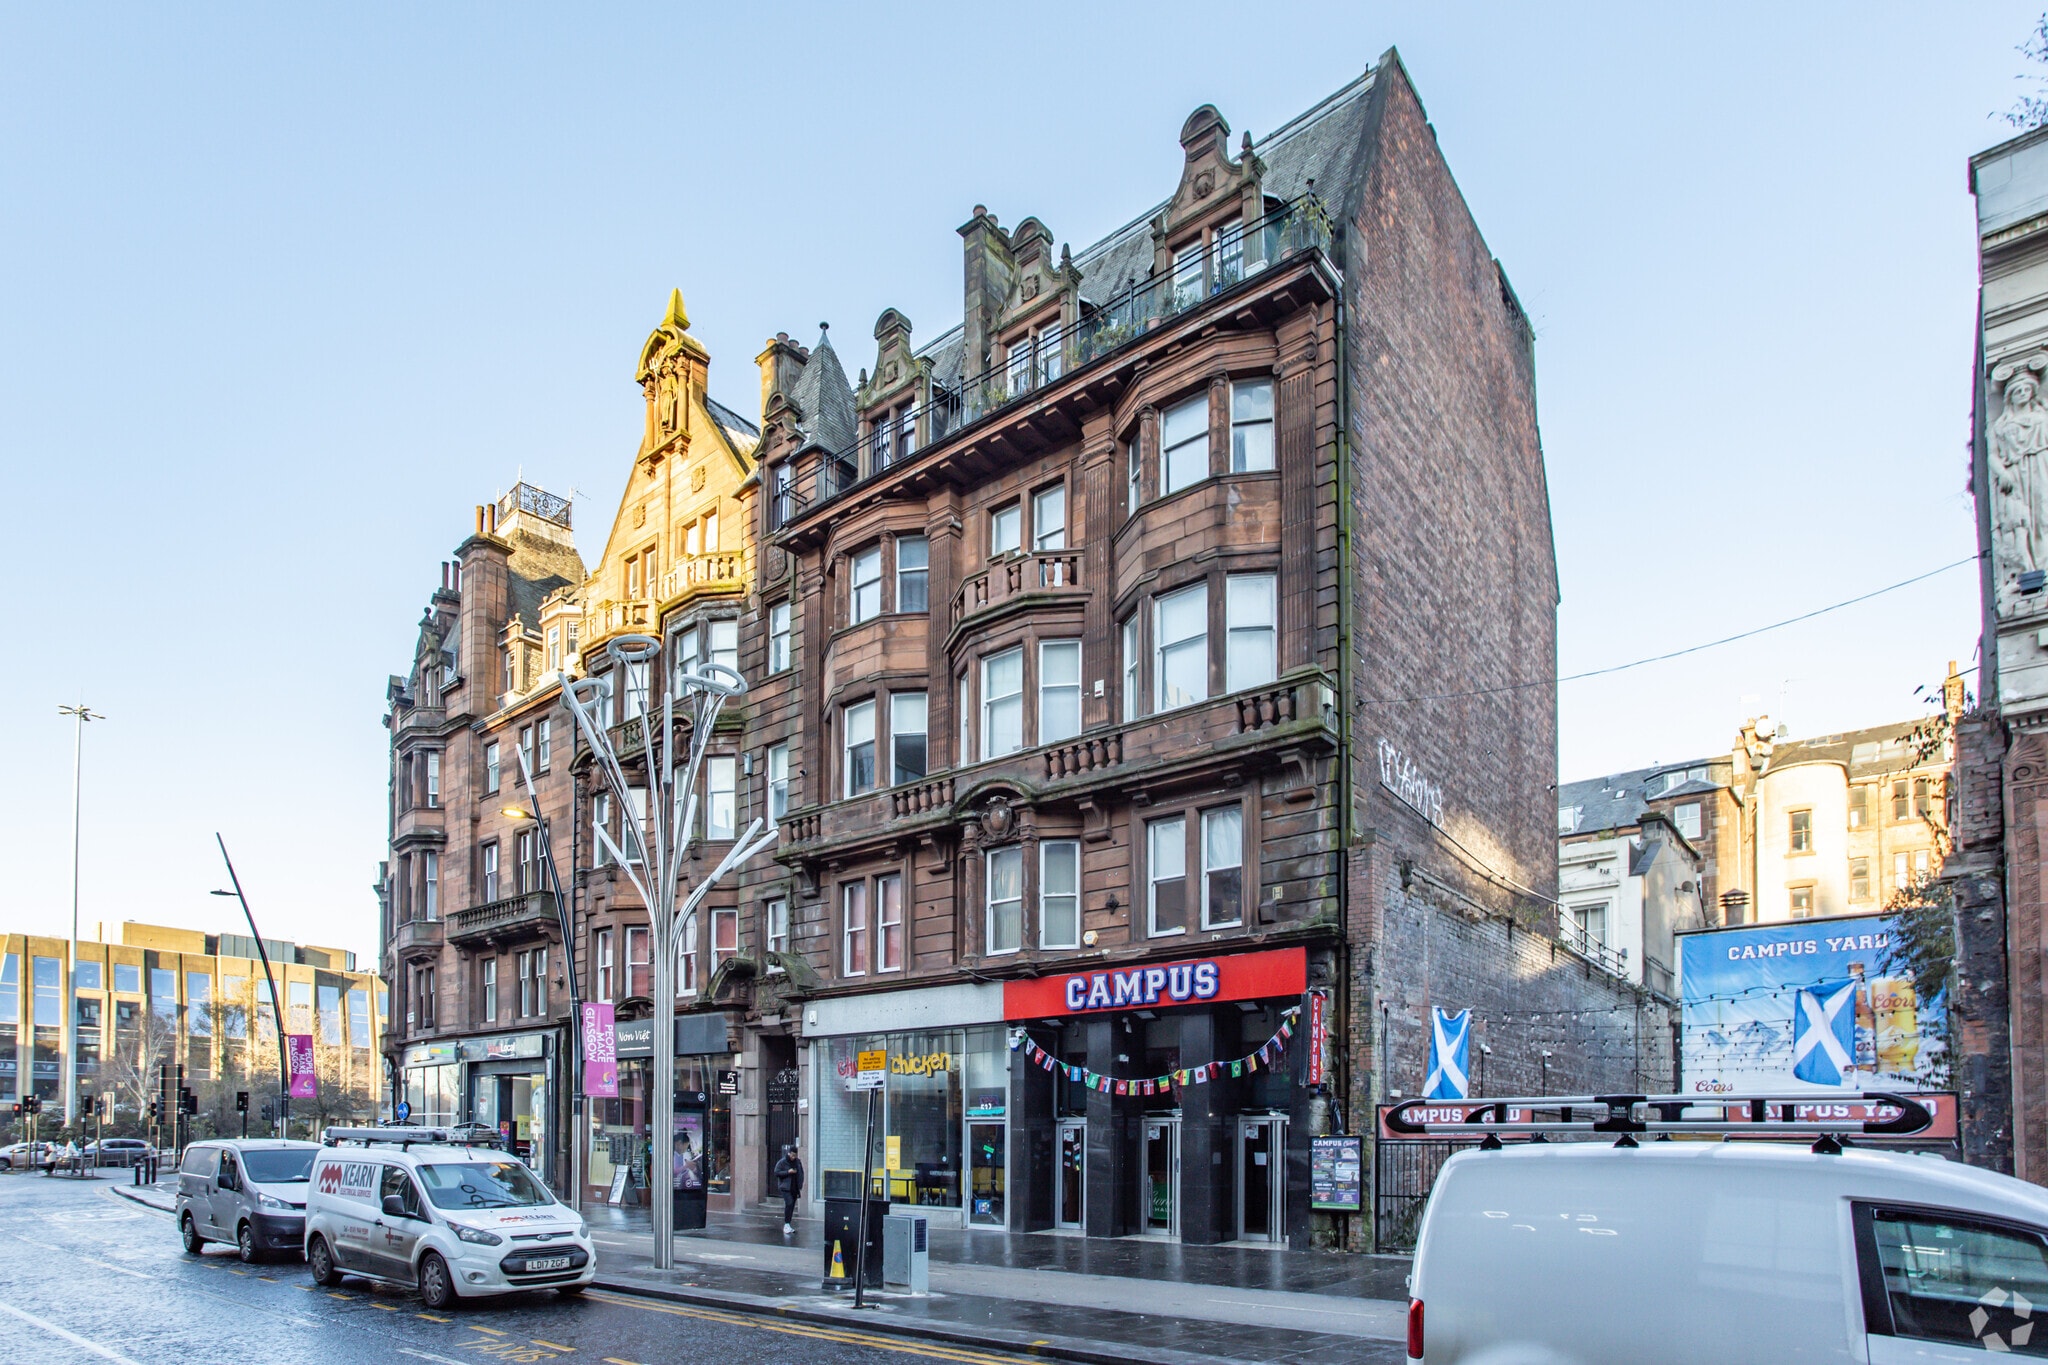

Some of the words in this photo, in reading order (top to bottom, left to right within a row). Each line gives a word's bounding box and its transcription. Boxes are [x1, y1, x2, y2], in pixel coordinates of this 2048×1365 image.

[1728, 940, 1817, 961] CAMPUS
[1825, 933, 1888, 952] YARD
[1066, 961, 1219, 1011] CAMPUS
[1873, 993, 1915, 1009] Coors
[585, 1007, 597, 1063] GLASGOW
[596, 1032, 606, 1063] MAKE
[605, 1024, 615, 1063] PEOPLE
[290, 1037, 299, 1075] GLASGOW
[299, 1053, 307, 1075] MAKE
[305, 1047, 314, 1075] PEOPLE
[1695, 1080, 1733, 1092] Coors
[1402, 1108, 1463, 1123] AMPUS
[342, 1163, 376, 1188] KEARN
